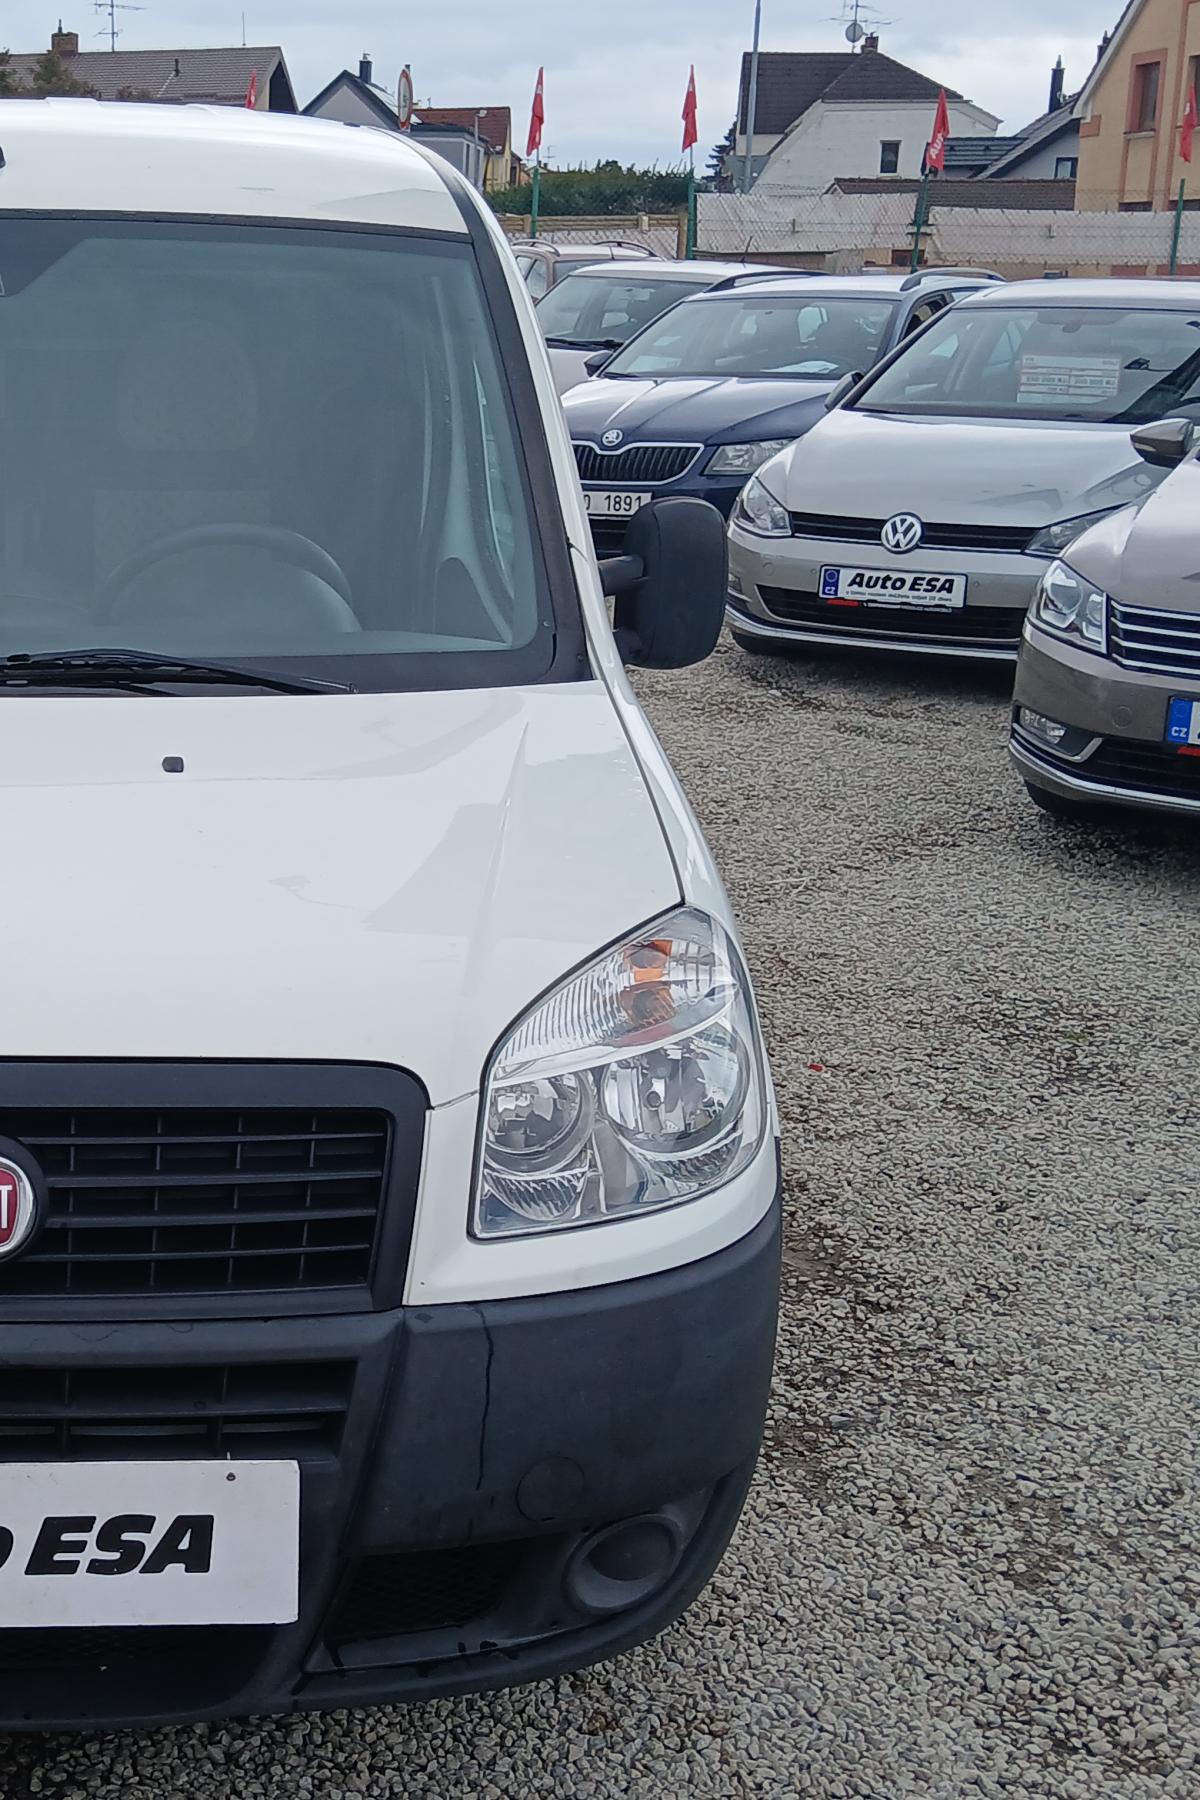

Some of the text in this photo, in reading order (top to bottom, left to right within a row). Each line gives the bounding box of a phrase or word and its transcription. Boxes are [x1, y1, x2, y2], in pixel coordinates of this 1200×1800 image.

[604, 494, 642, 512] 1891
[847, 572, 955, 594] Auto ESA
[1171, 726, 1188, 738] CZ
[24, 1513, 215, 1577] ESA
